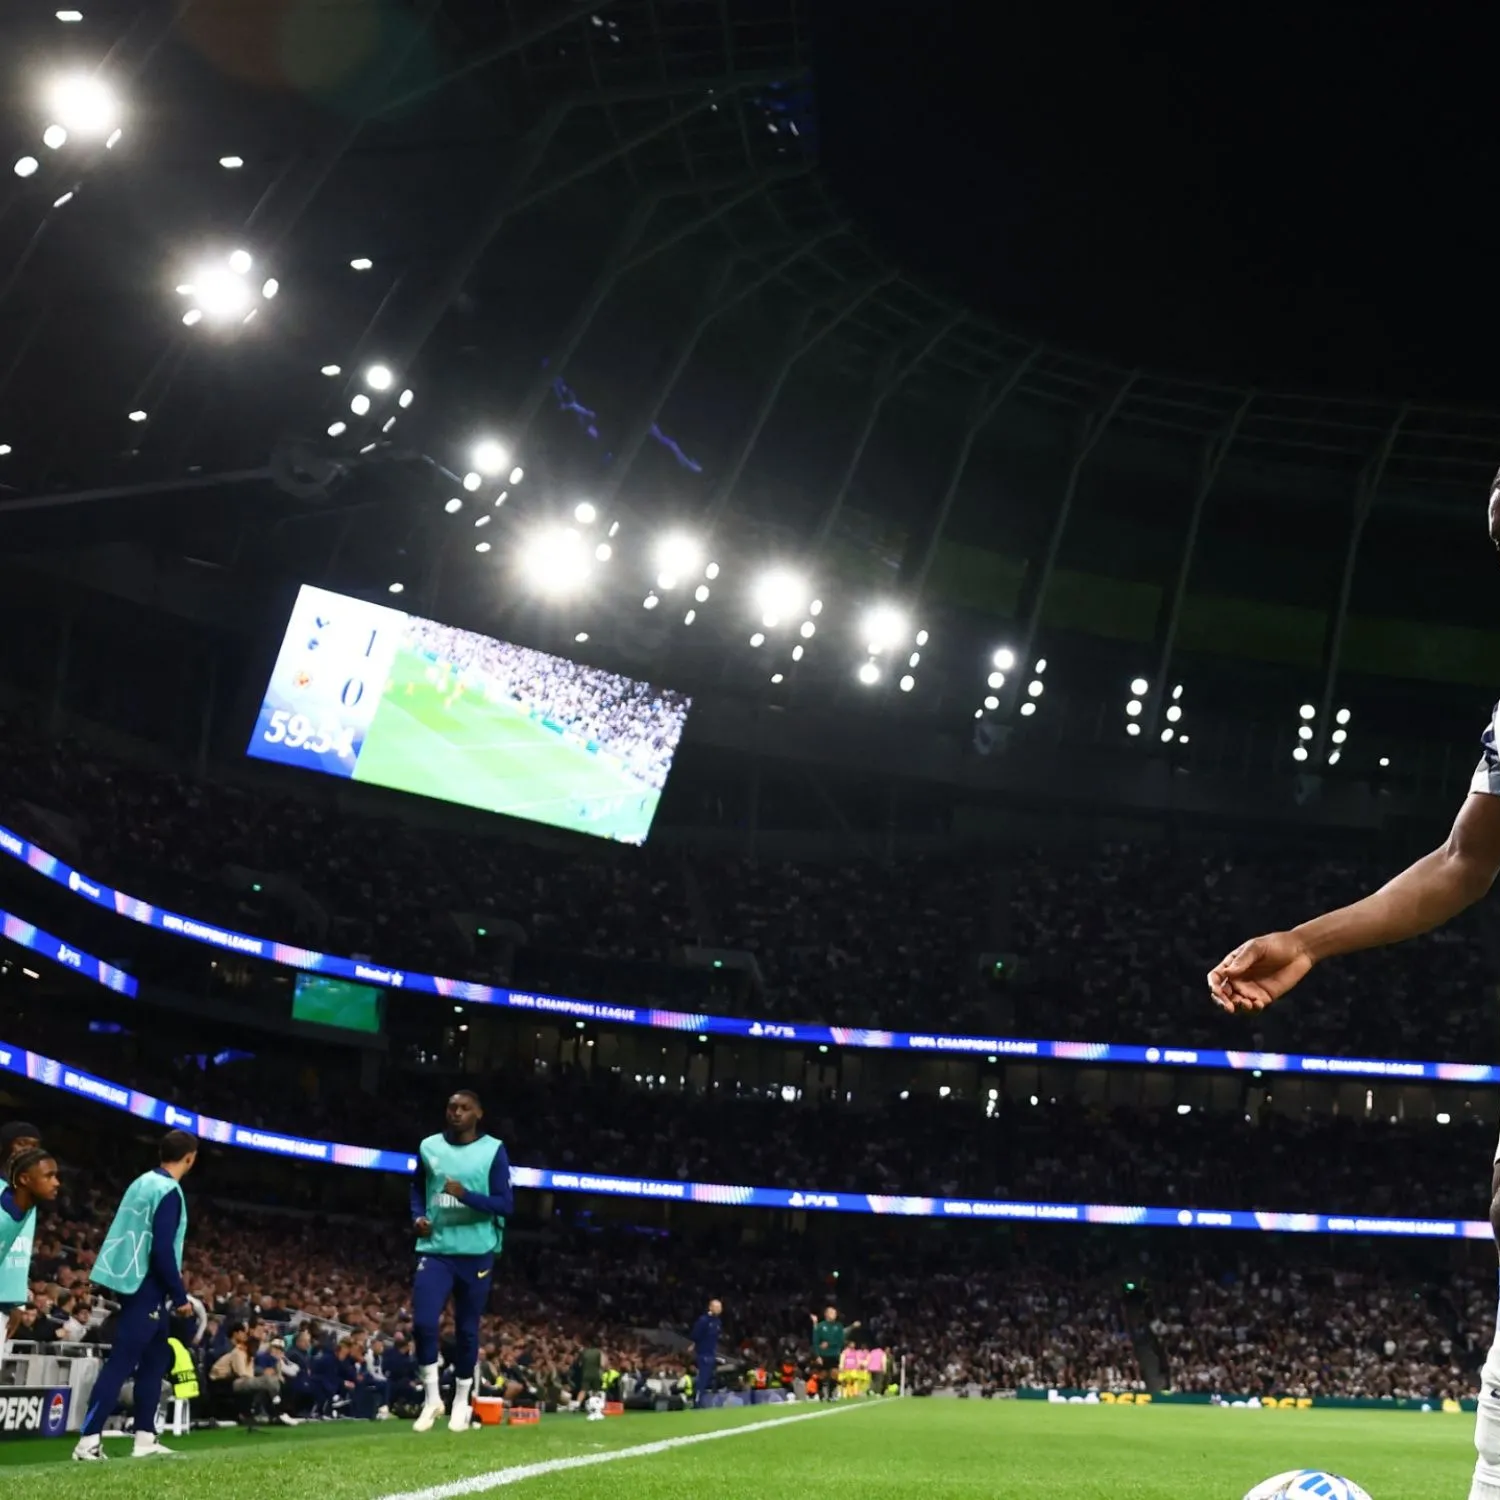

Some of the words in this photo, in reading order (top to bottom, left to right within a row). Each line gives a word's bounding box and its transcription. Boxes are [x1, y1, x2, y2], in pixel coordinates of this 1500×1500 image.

[342, 678, 363, 706] 0
[509, 994, 535, 1006] UEFA
[537, 997, 593, 1015] CHAMPIONS
[596, 1006, 635, 1020] LEAGUE
